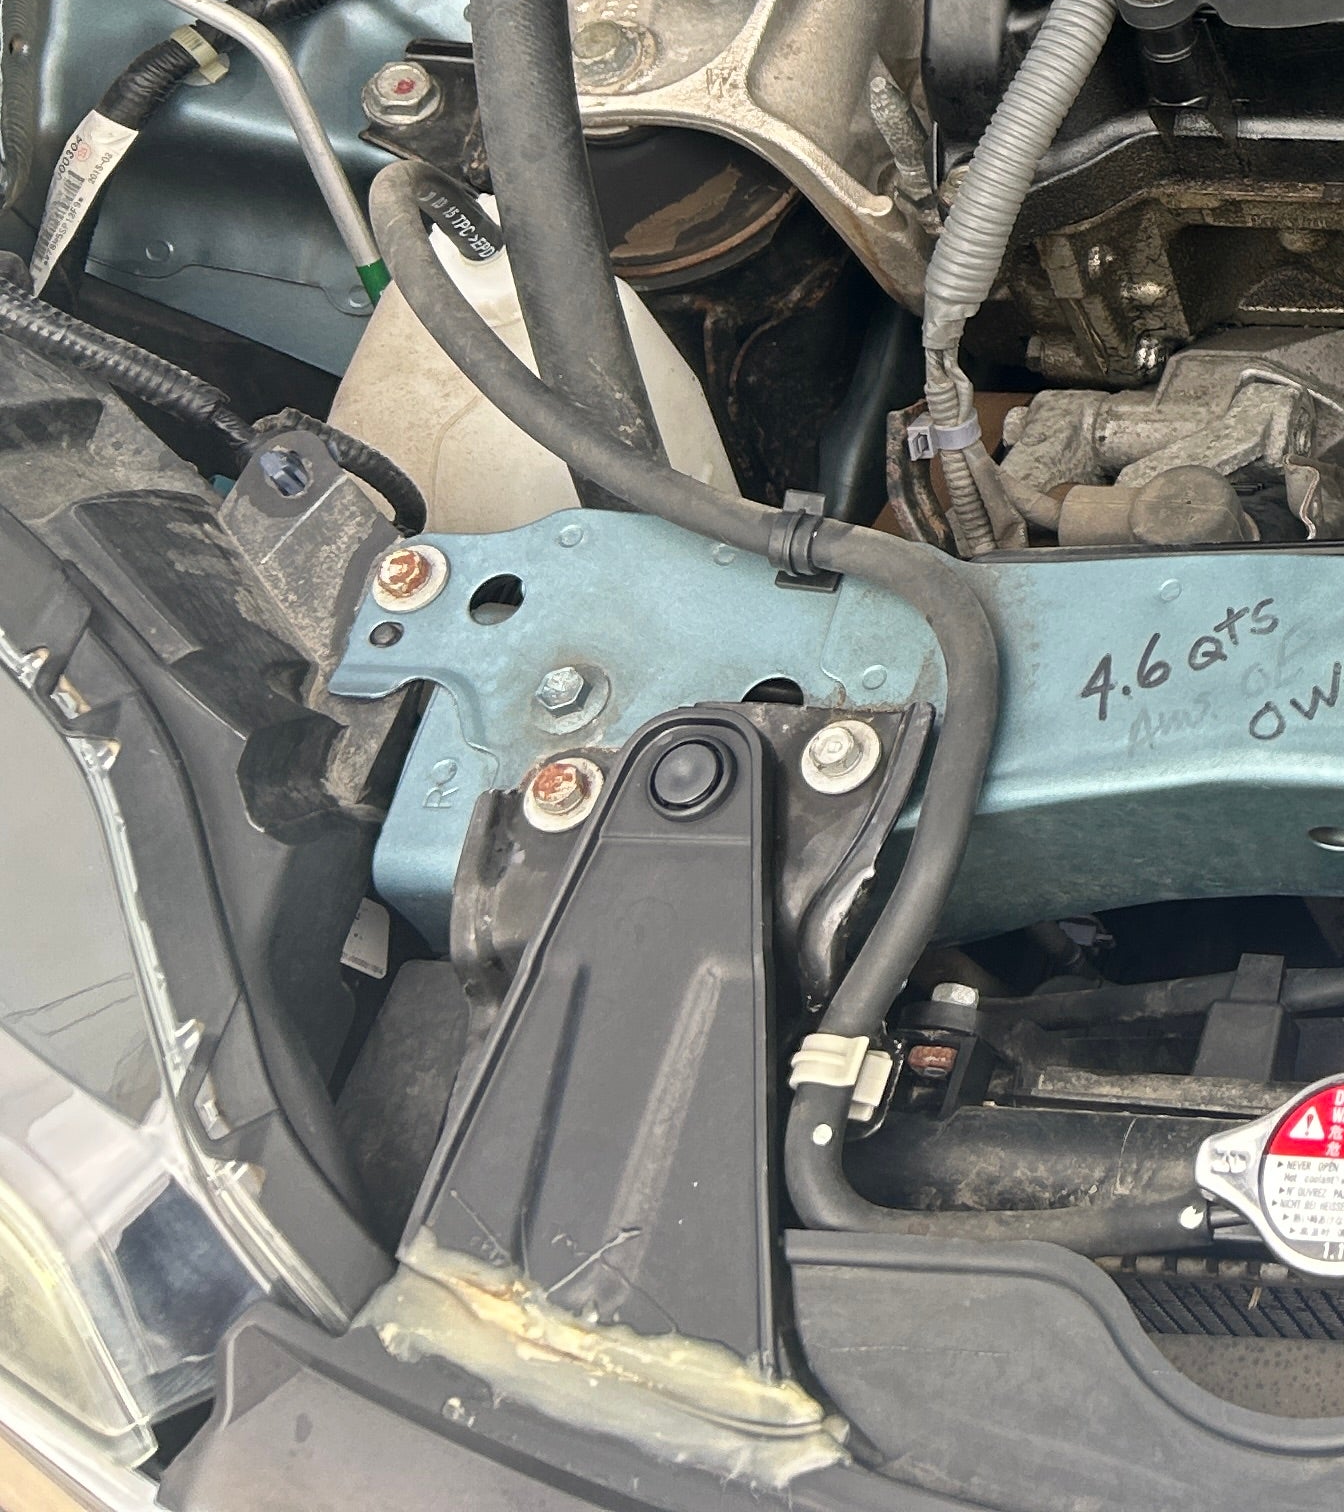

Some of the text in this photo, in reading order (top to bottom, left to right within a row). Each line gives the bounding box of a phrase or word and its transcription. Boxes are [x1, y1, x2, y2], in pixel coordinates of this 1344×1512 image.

[449, 215, 476, 237] TPC
[1080, 632, 1171, 720] 4.6
[1286, 1161, 1311, 1170] NEVER
[1318, 1162, 1339, 1172] OPEN
